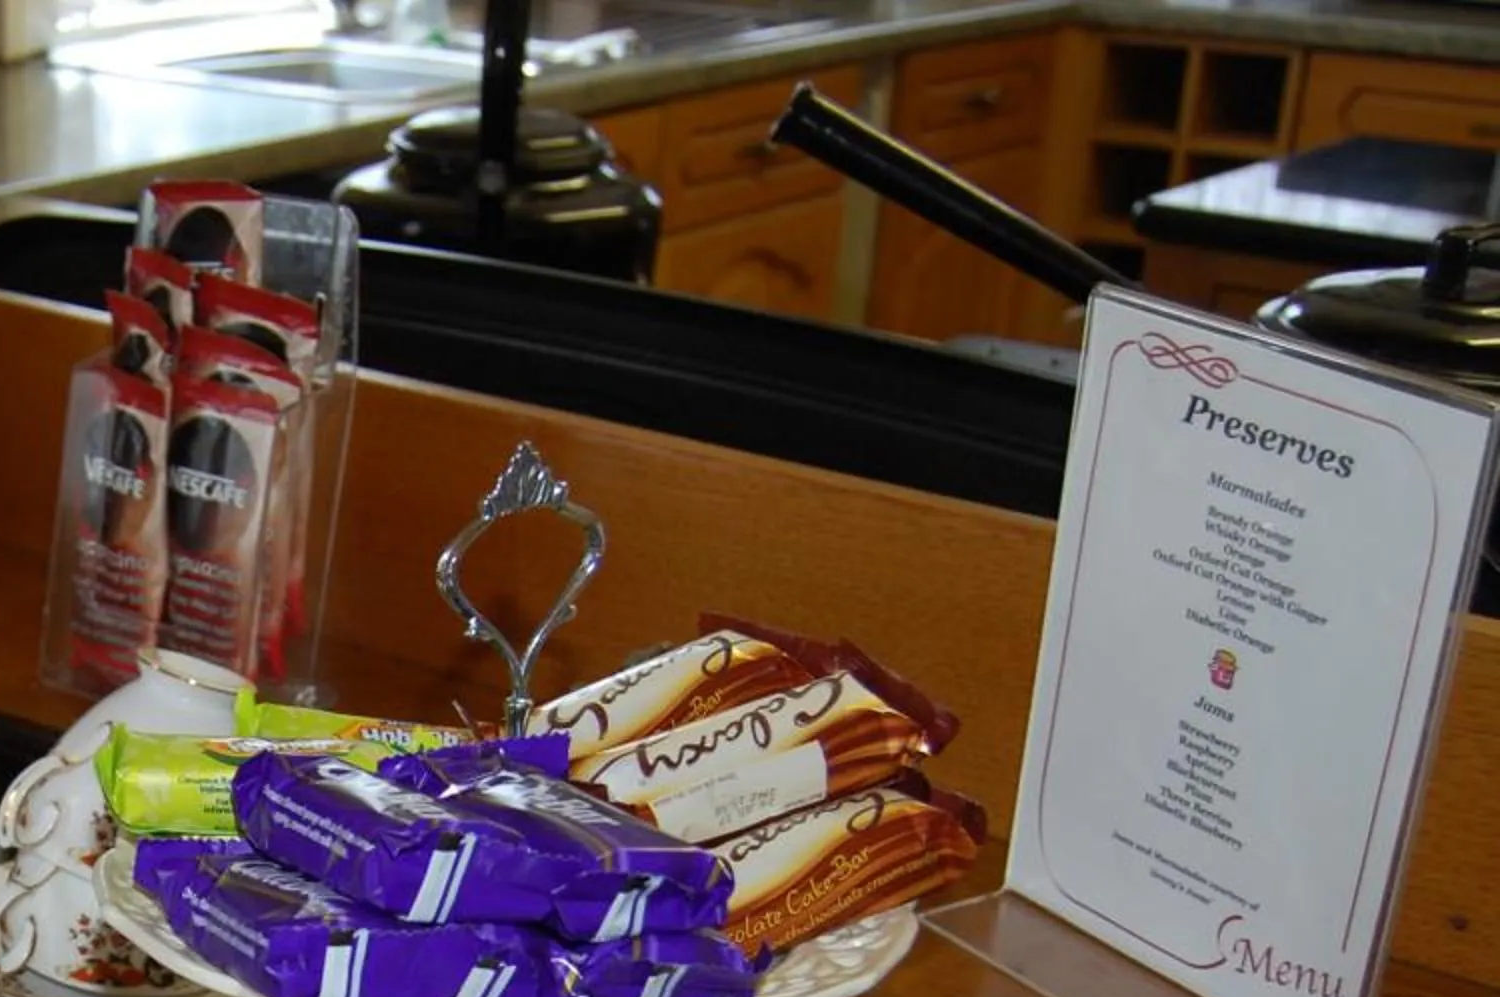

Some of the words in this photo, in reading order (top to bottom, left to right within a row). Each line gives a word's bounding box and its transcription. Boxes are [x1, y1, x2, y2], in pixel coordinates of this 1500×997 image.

[1183, 394, 1355, 479] Preserves
[1206, 471, 1307, 519] Marmalades
[1207, 505, 1249, 531] Brandy
[1251, 521, 1294, 547] Orange
[1189, 545, 1230, 570] Oxford
[1252, 572, 1296, 597] Orange
[1223, 543, 1266, 568] Orange
[1249, 537, 1292, 563] Orange
[1152, 548, 1193, 572] Oxford
[1216, 574, 1257, 598] Orange
[1259, 592, 1285, 609] with
[1287, 601, 1328, 626] Ginger
[1217, 588, 1256, 613] Lemon
[1185, 607, 1231, 636] Diabetic
[1233, 628, 1275, 655] Orange
[594, 670, 849, 782] Galaxy
[1193, 696, 1235, 723] Jams
[1178, 719, 1241, 757] Strawberry
[1179, 734, 1235, 771] Raspberry
[786, 877, 835, 915] Cake
[832, 845, 871, 881] Bar
